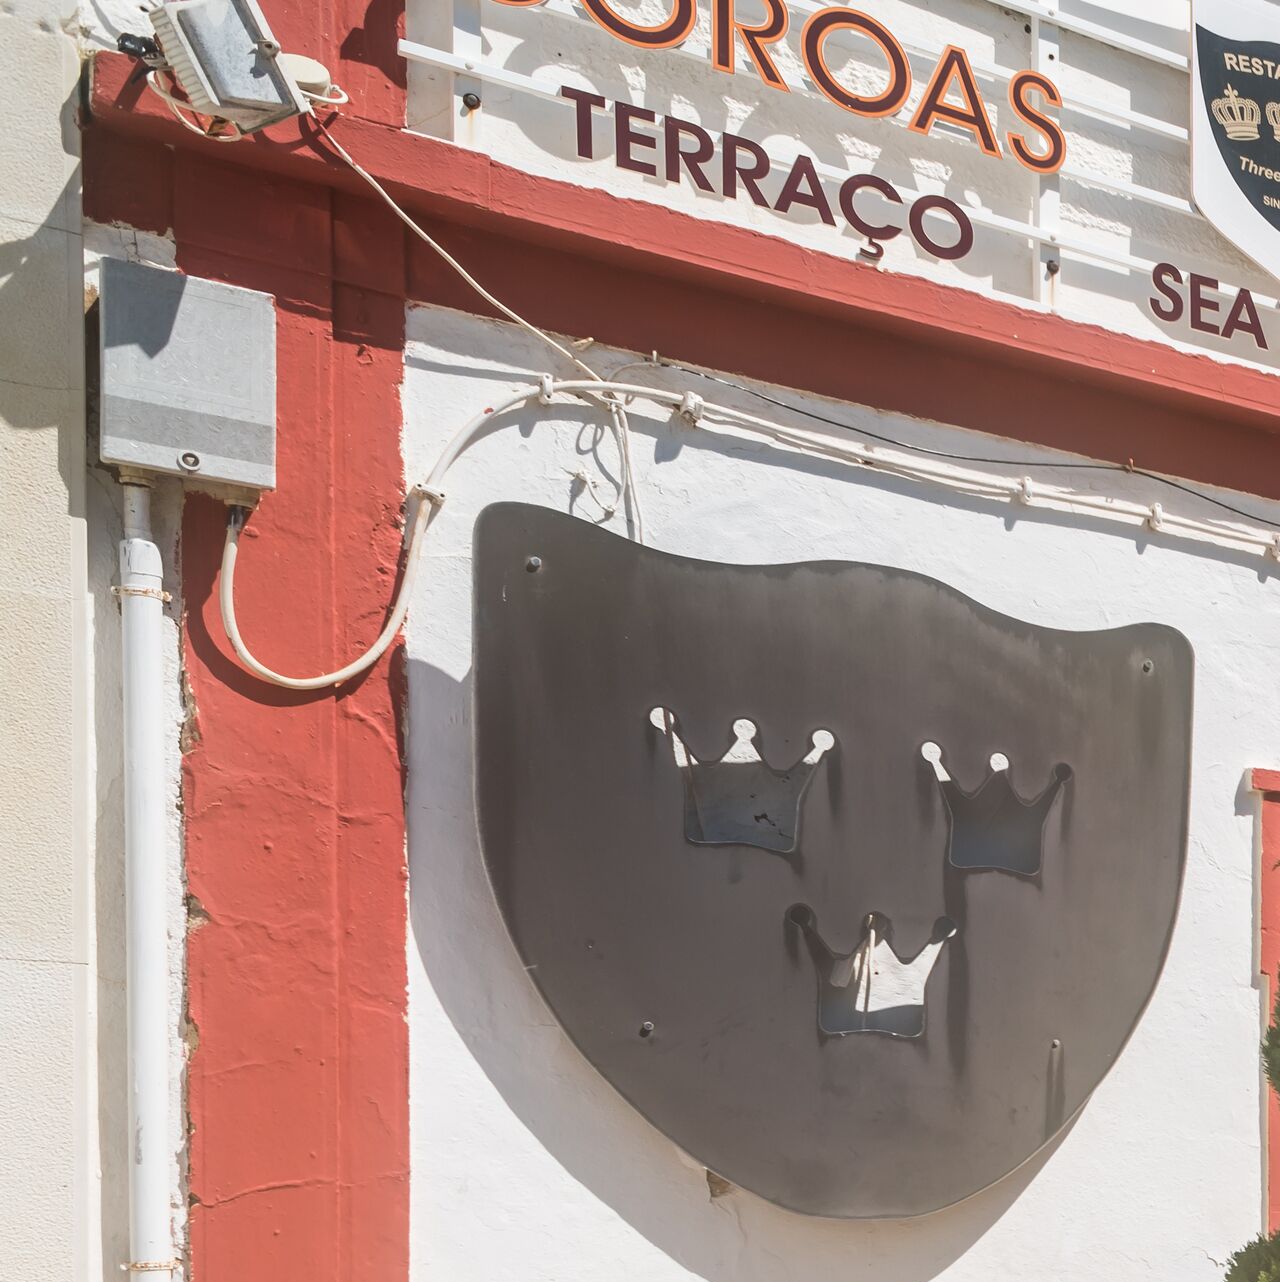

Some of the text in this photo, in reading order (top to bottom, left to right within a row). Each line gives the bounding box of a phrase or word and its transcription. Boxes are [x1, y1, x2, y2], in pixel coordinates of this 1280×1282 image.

[488, 0, 1067, 174] ROAS
[561, 86, 974, 259] TERRAÇO
[1149, 262, 1269, 351] SEA
